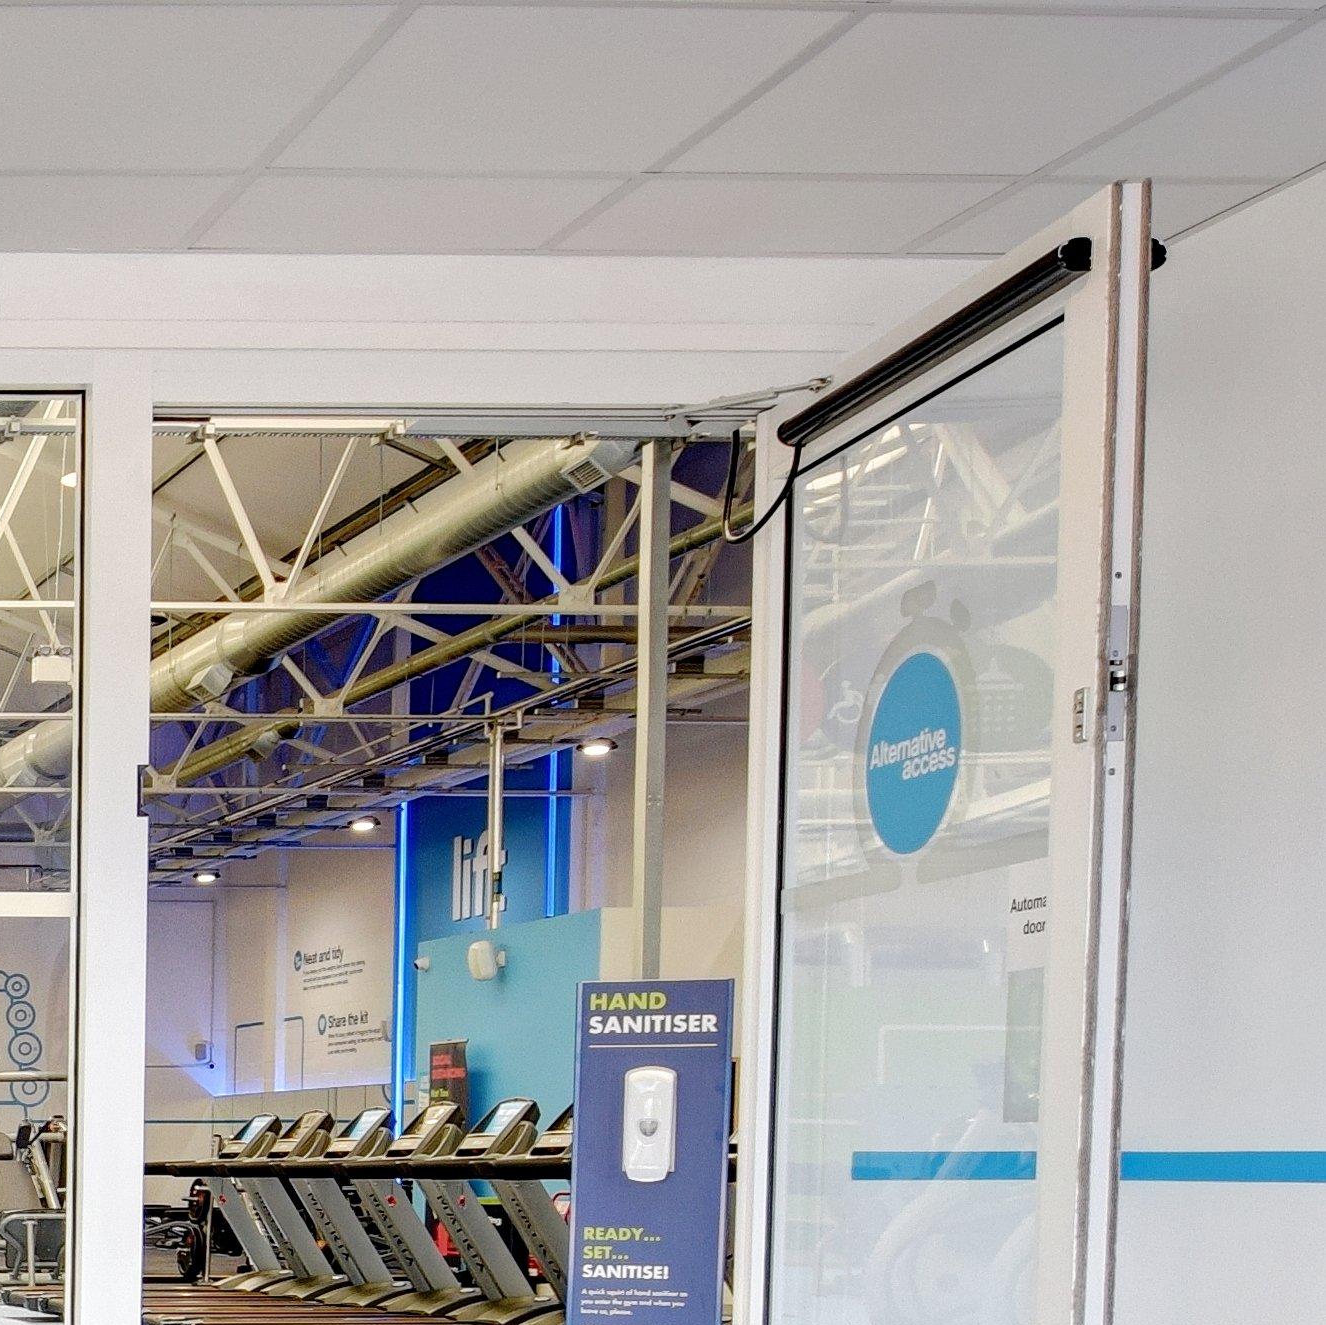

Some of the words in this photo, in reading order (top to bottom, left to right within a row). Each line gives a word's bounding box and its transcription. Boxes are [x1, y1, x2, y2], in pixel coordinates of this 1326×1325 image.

[870, 727, 946, 770] Alternative
[902, 745, 956, 780] access
[589, 992, 667, 1011] HAND
[588, 1014, 718, 1035] SANITISER
[583, 1226, 661, 1241] READY...
[583, 1246, 629, 1260] SET...
[582, 1264, 669, 1280] SANITISE!
